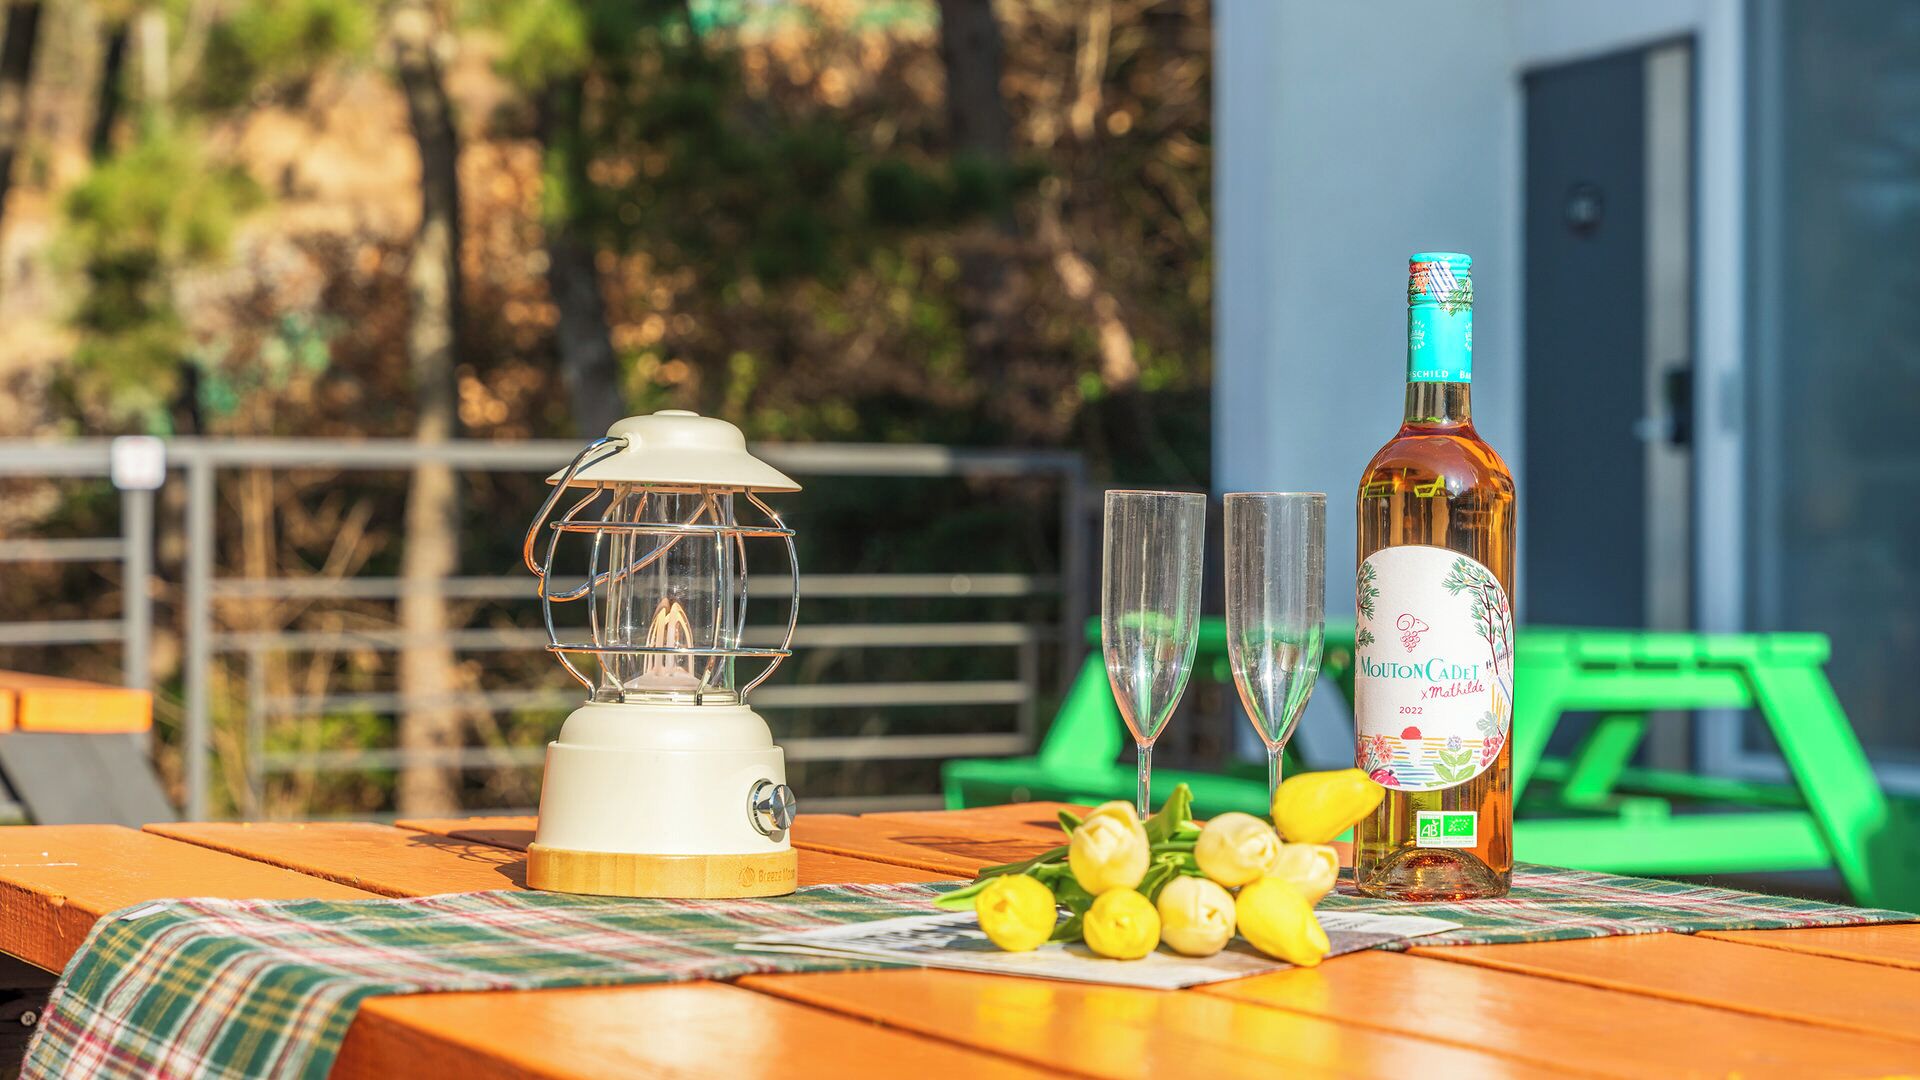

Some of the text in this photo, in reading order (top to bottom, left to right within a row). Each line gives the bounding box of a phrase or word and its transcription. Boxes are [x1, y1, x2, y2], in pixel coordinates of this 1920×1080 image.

[1409, 370, 1449, 378] SCHILD
[1425, 658, 1479, 682] CADET
[1399, 706, 1423, 715] 2022
[1421, 824, 1438, 837] AB
